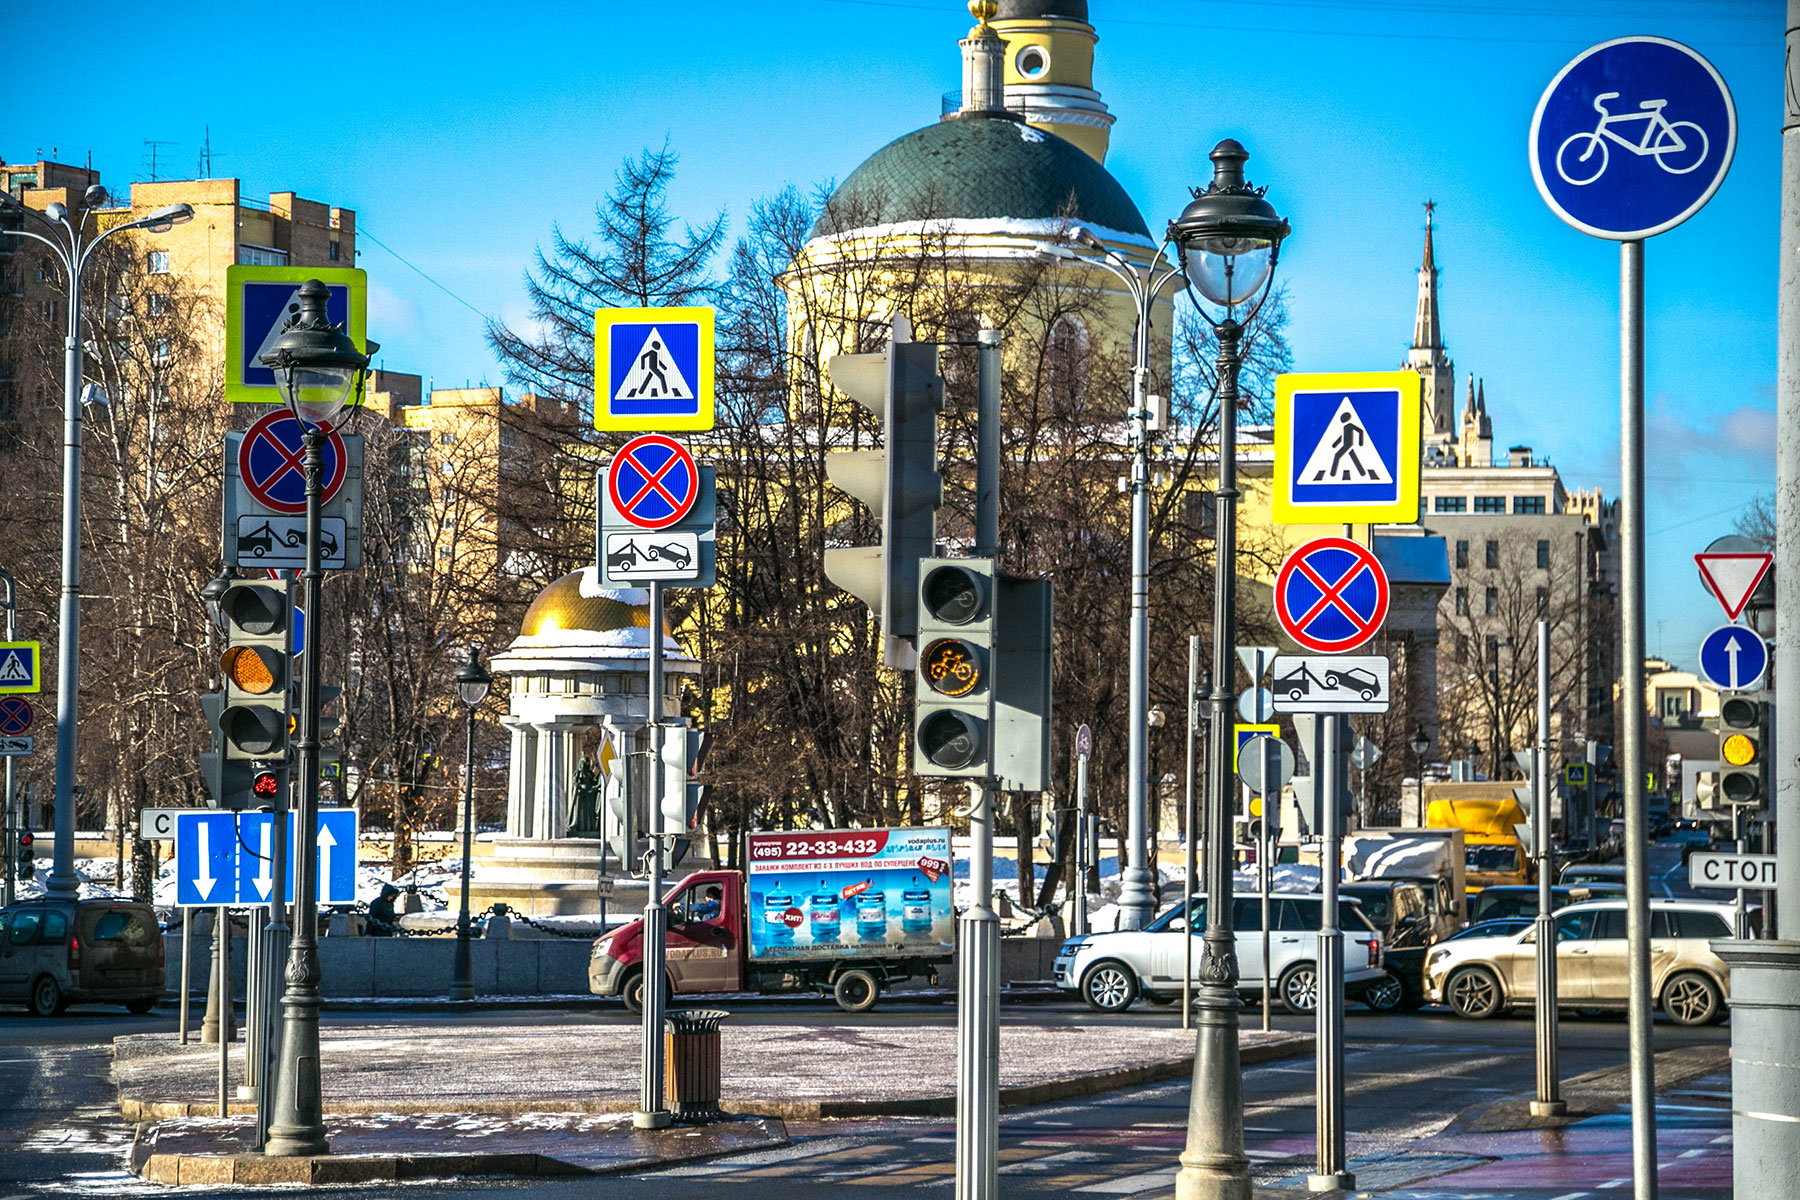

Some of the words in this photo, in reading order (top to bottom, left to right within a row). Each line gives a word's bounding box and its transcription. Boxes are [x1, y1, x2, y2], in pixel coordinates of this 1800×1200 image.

[753, 847, 782, 858] (495)
[786, 839, 877, 856] 22-33-432
[755, 864, 779, 872] ЗАКАЖИ
[781, 863, 812, 871] КОМПЛЕКТ
[814, 862, 822, 870] ИЗ
[835, 861, 858, 870] ЛУЧШИХ
[874, 860, 882, 868] ПО
[883, 859, 916, 868] СУПЕРЦЕНЕ
[920, 859, 940, 870] 999
[1704, 860, 1776, 882] СТОП
[785, 914, 802, 922] ХИТ!
[765, 944, 809, 952] БЕСПЛАТНАЯ
[811, 942, 850, 951] ДОСТАВКА
